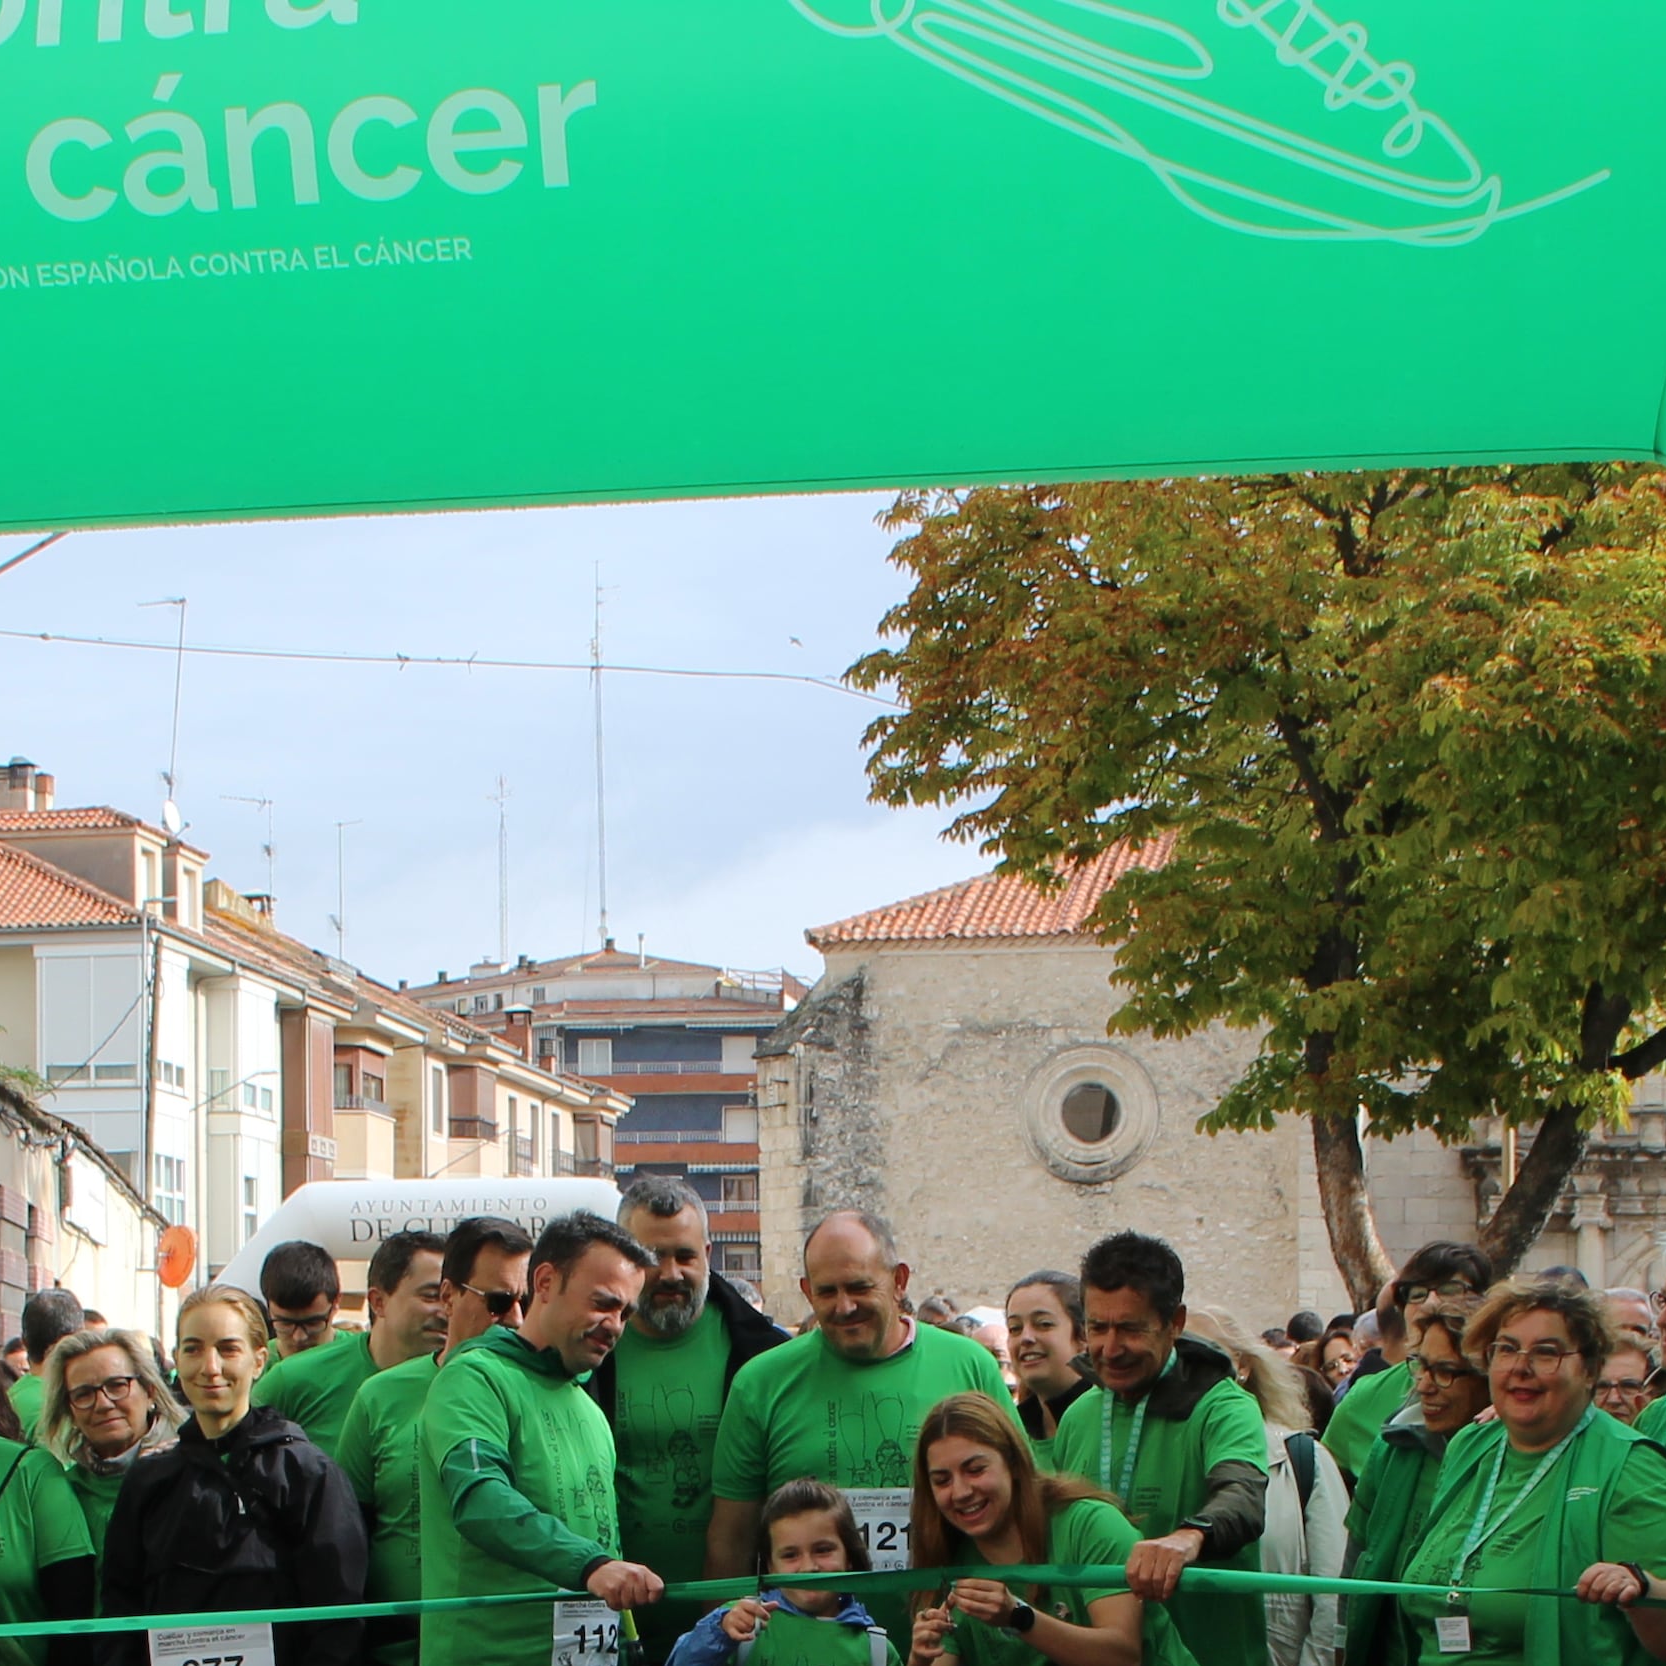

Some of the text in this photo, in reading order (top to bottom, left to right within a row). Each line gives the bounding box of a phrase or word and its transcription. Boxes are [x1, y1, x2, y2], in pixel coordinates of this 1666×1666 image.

[25, 72, 597, 222] cáncer
[37, 250, 184, 288] ESPAÑOLA
[189, 246, 308, 277] CONTRA
[313, 243, 349, 270] EL
[354, 236, 472, 266] CÁNCER
[350, 1197, 548, 1214] AYUNTAMIENTO
